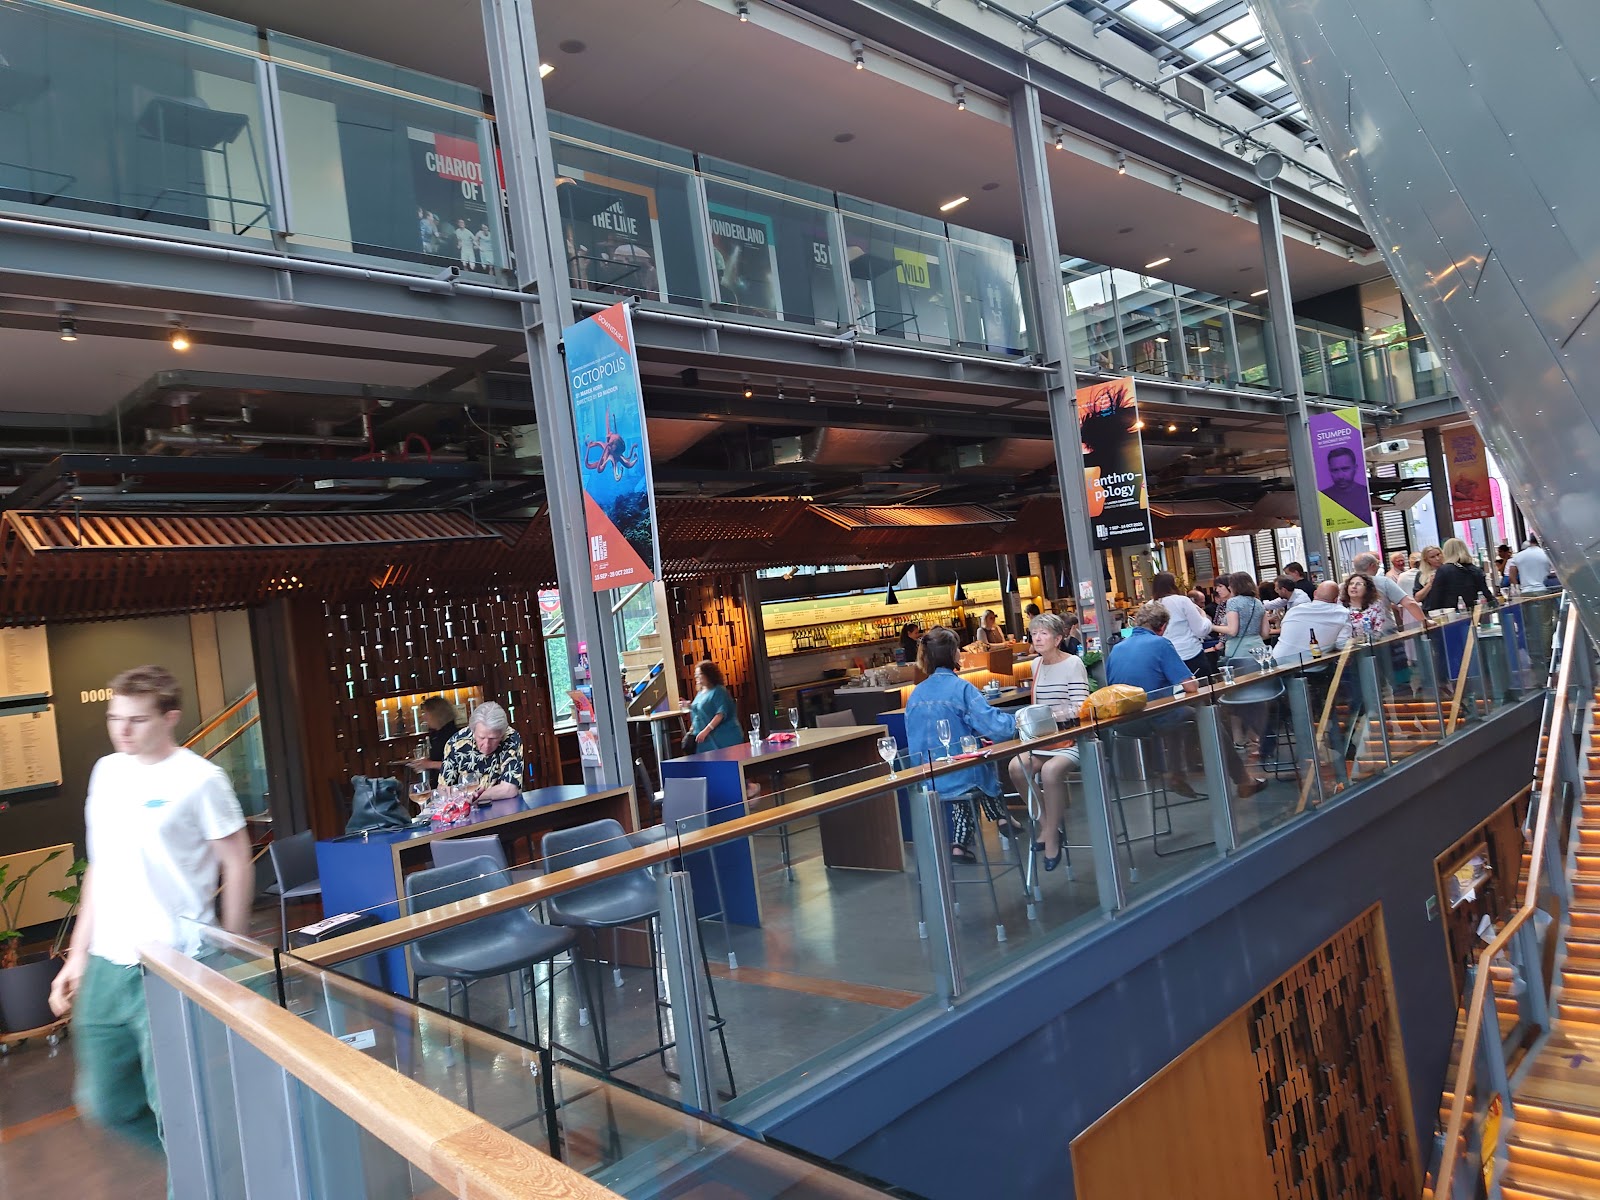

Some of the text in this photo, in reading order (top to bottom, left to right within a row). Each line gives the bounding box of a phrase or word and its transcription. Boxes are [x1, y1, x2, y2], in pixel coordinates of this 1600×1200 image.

[425, 152, 483, 181] CHARIOT
[461, 179, 479, 200] OF
[813, 242, 828, 265] 55
[902, 263, 926, 284] WILD
[597, 314, 624, 342] DOWNSTAIRS
[573, 356, 626, 389] OCTOPOLIS
[1316, 427, 1352, 441] STUMPED
[1093, 472, 1142, 487] anthro-
[1094, 484, 1136, 502] pology
